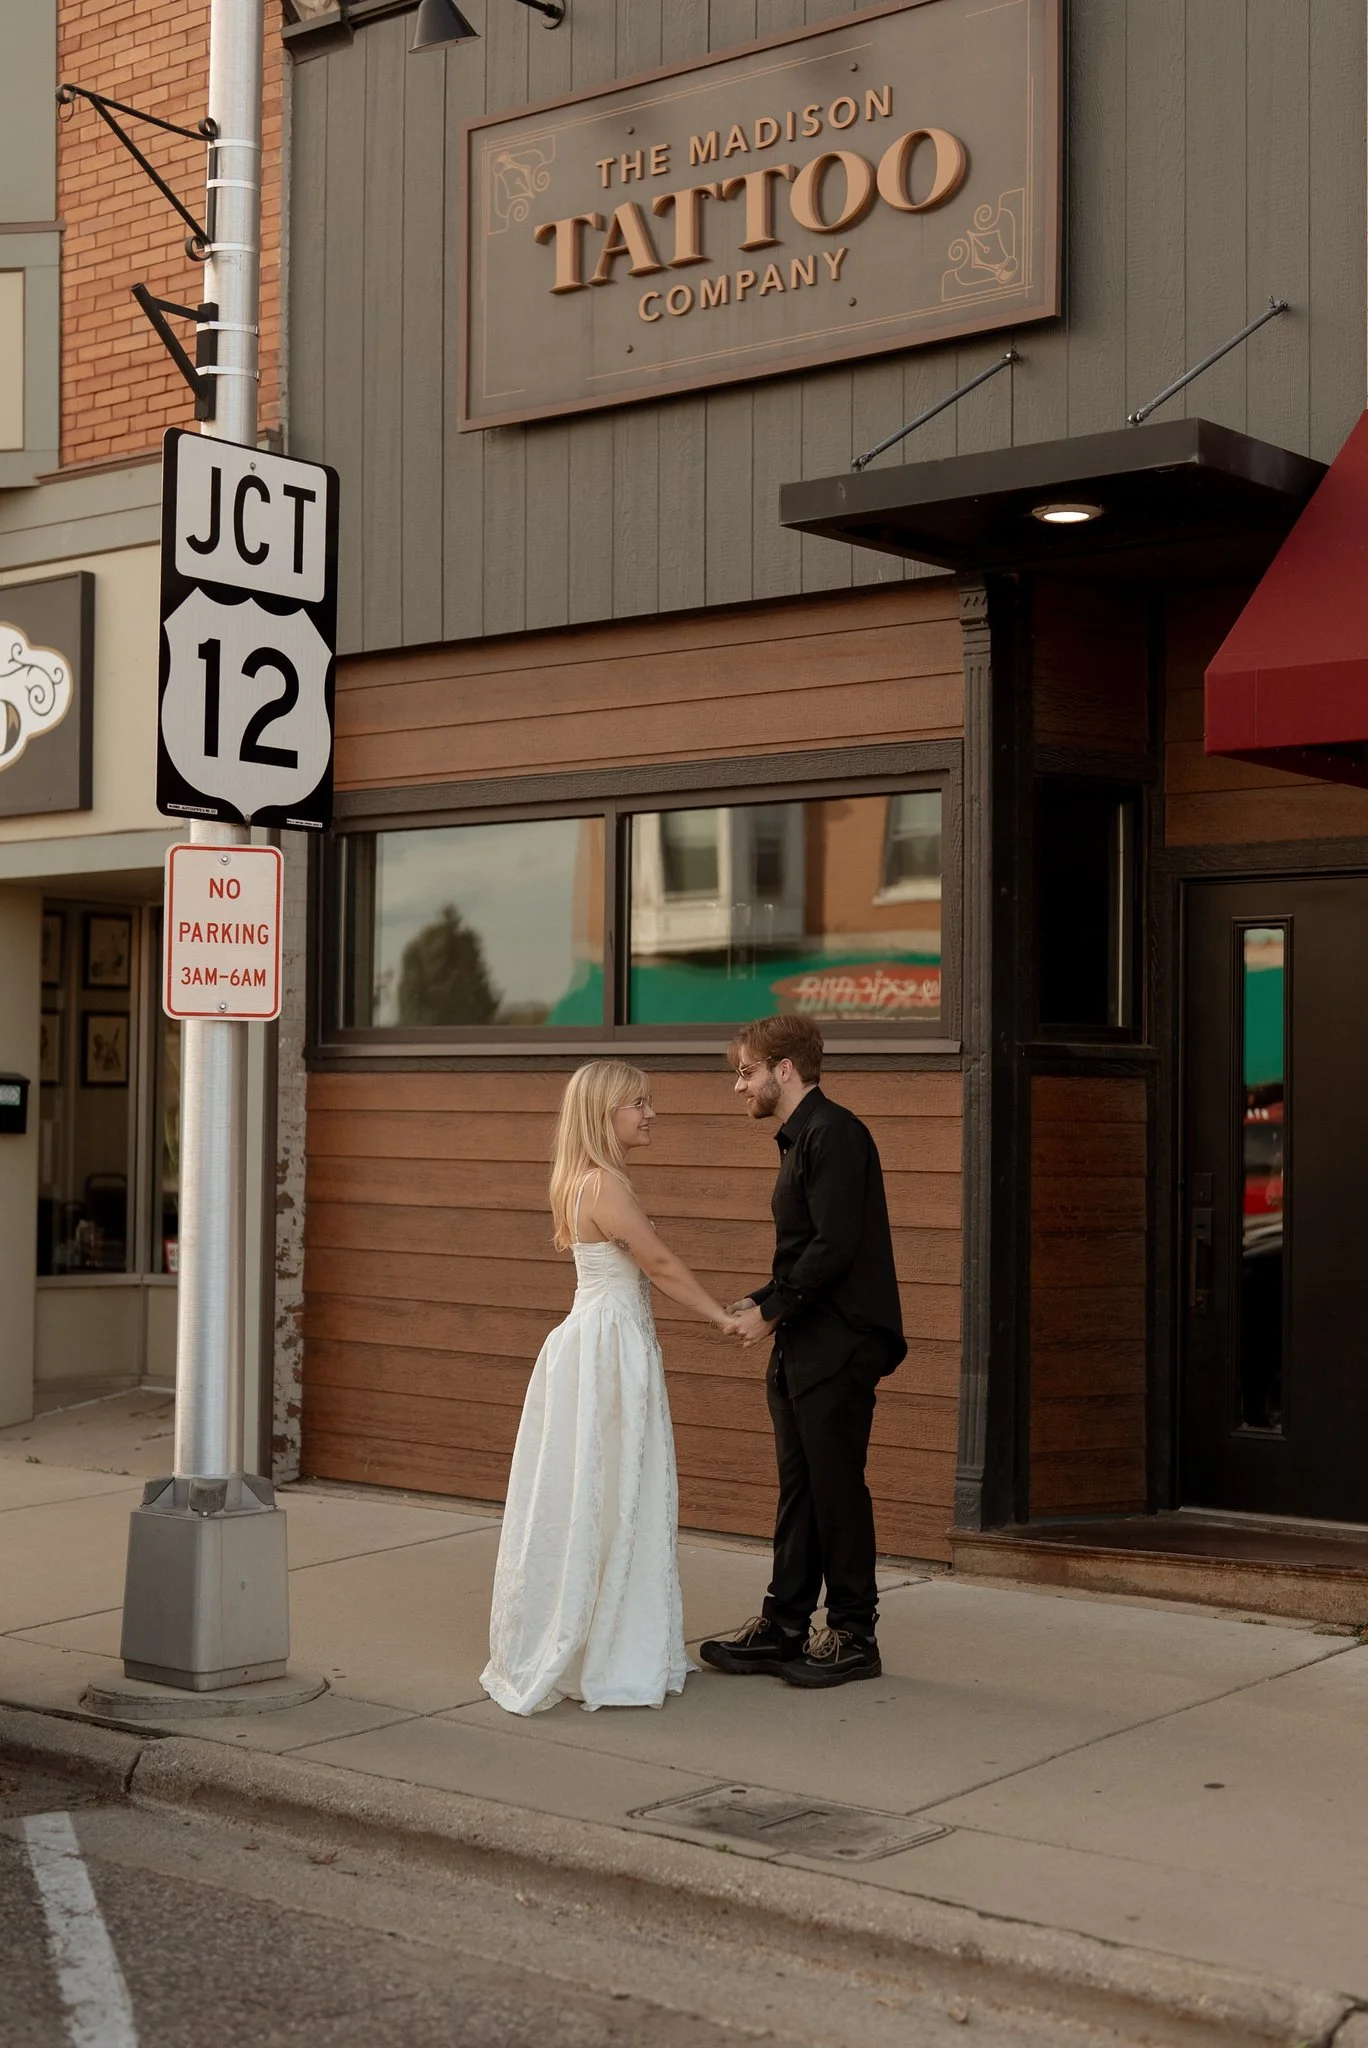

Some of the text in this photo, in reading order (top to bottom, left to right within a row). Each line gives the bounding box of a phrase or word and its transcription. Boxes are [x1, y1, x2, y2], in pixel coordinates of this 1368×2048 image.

[596, 84, 894, 188] THE MADISON
[534, 127, 969, 296] TATTOO
[638, 247, 849, 323] COMPANY
[186, 466, 316, 575] JCT
[198, 637, 299, 770] 12
[179, 922, 269, 945] PARKING
[209, 878, 241, 899] NO
[181, 966, 267, 987] 3AM-6AM
